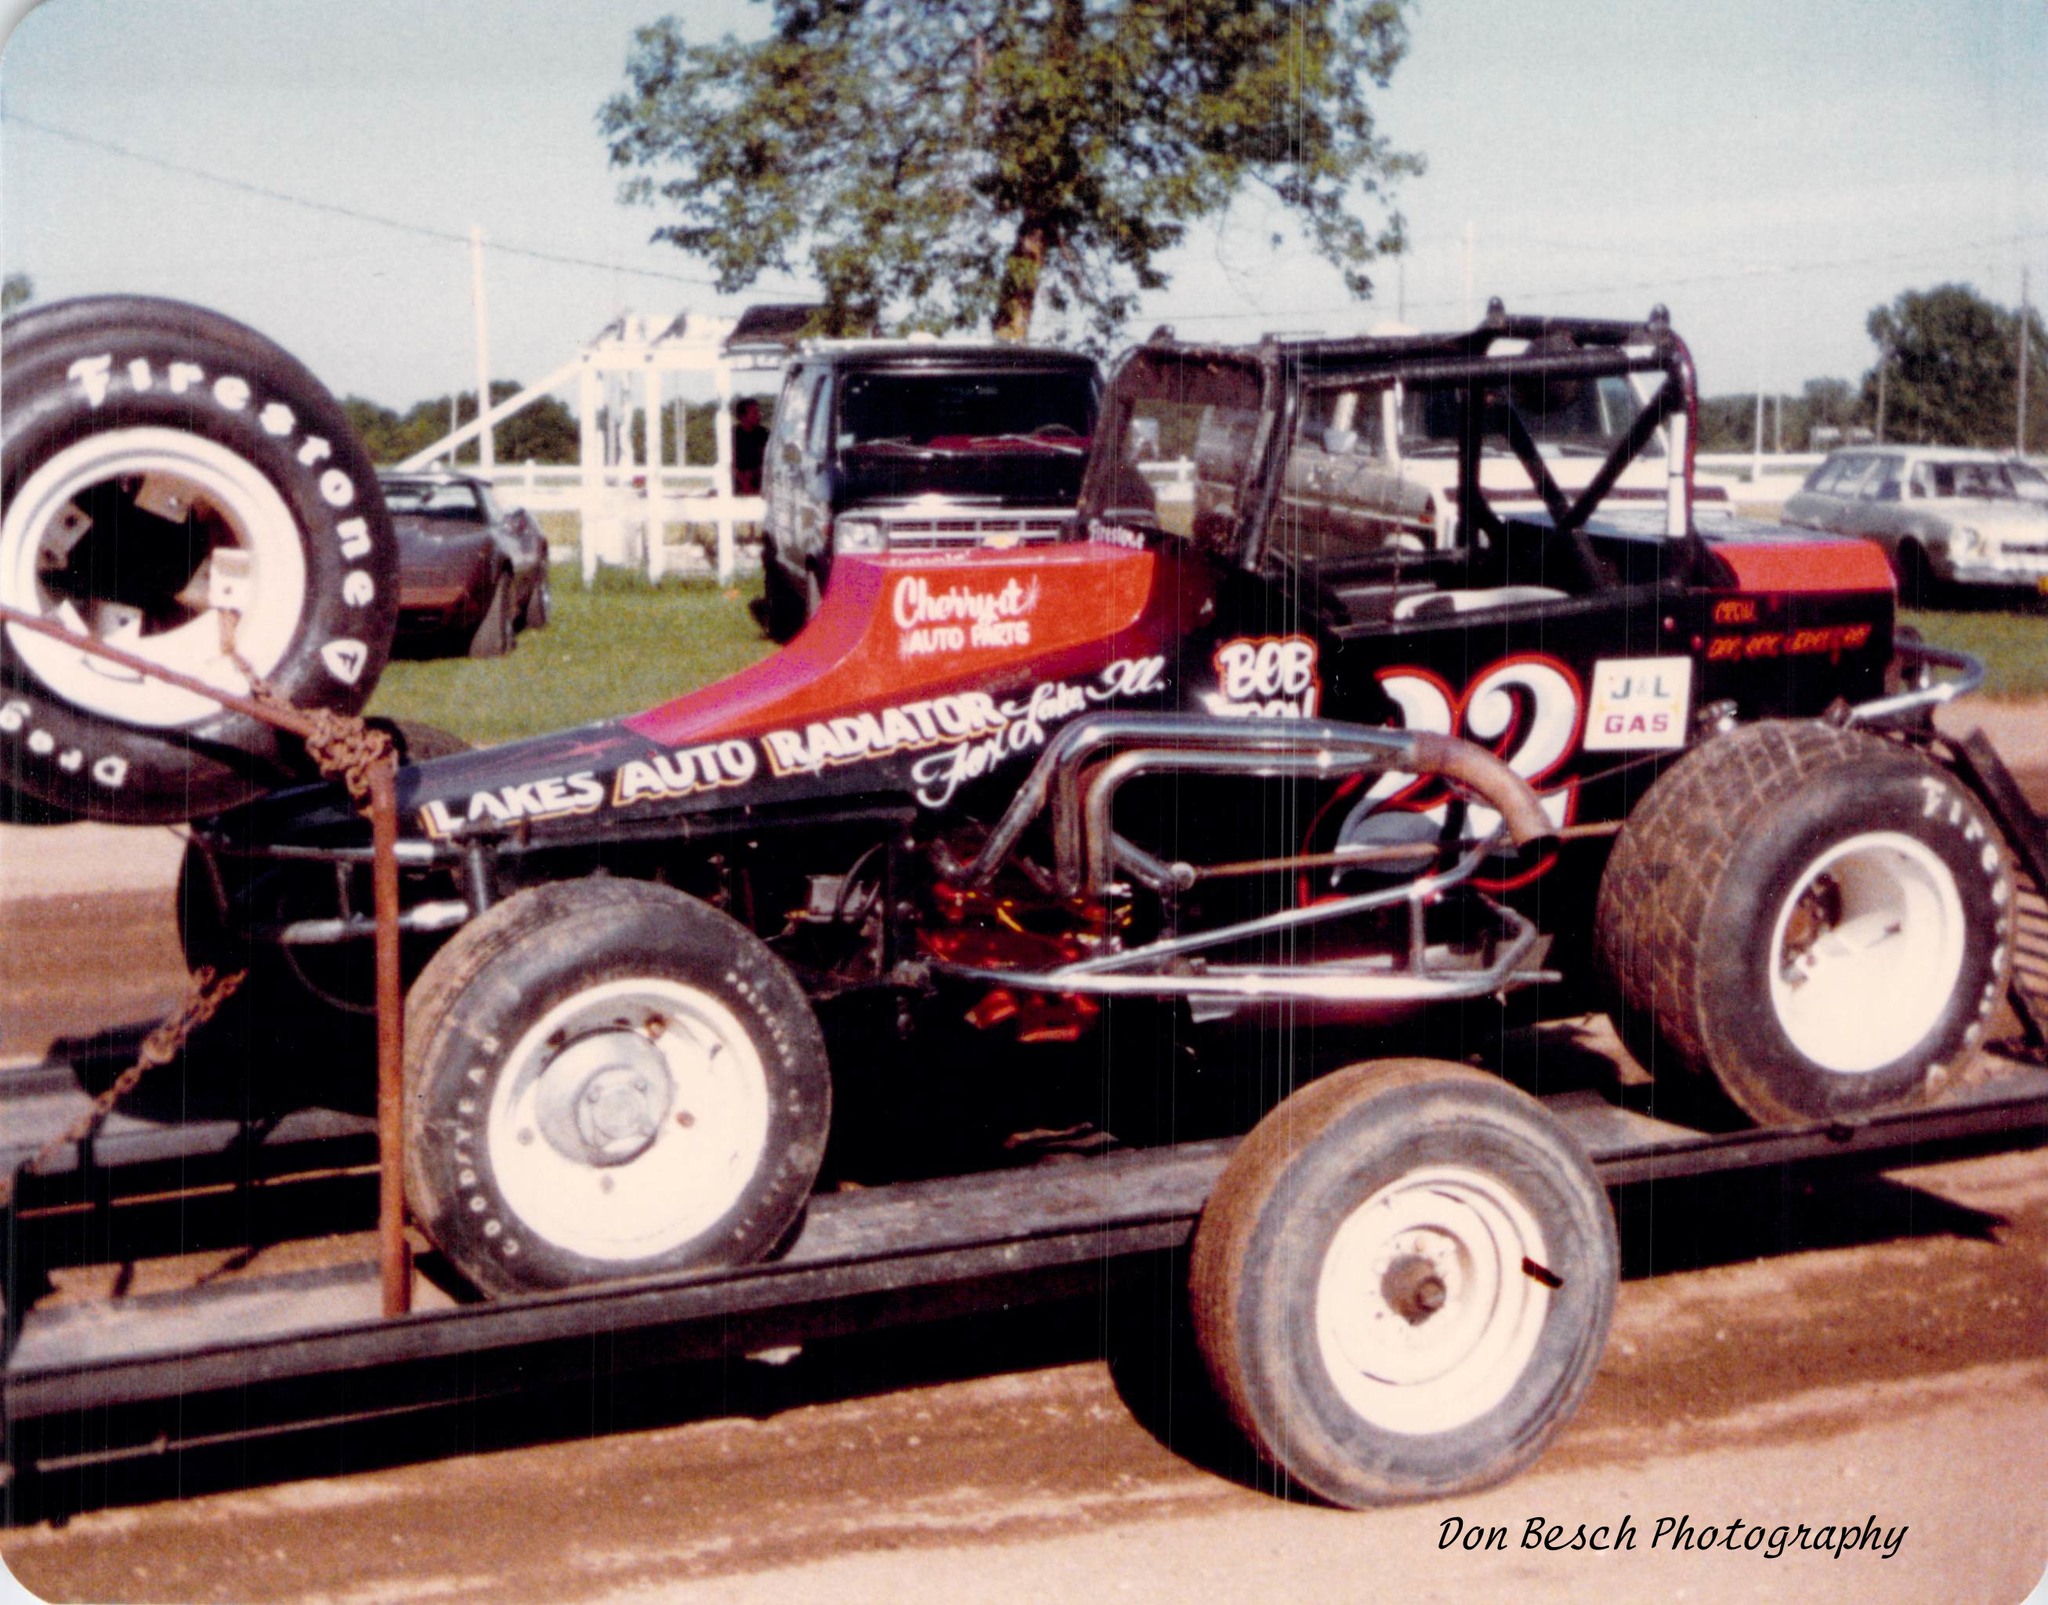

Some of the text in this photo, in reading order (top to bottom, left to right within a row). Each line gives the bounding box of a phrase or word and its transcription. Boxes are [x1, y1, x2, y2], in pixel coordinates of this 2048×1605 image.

[68, 353, 375, 608] Firestone
[903, 620, 1032, 656] AUTO PARTS
[1216, 638, 1316, 700] BOB
[1604, 713, 1670, 735] GAS
[420, 691, 1007, 838] LAKES AUTO RADIATOR
